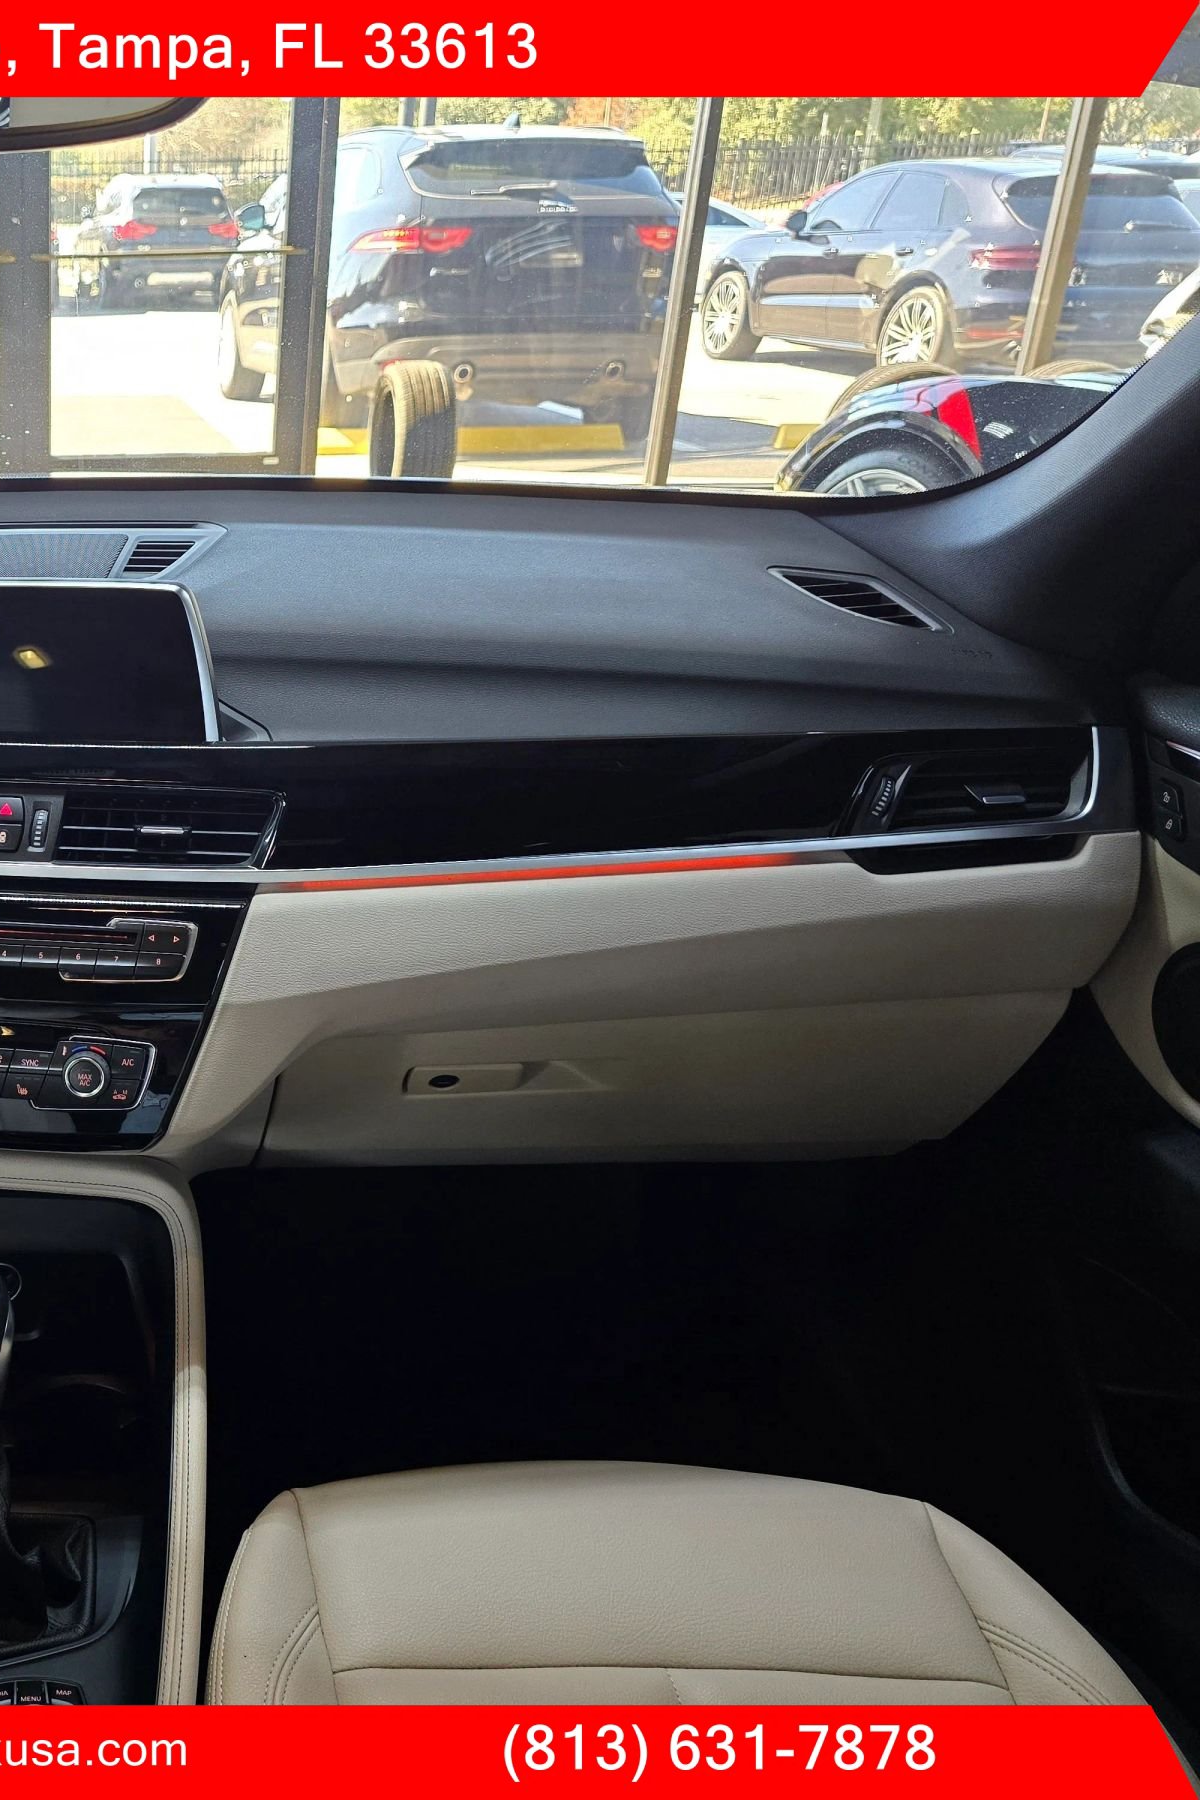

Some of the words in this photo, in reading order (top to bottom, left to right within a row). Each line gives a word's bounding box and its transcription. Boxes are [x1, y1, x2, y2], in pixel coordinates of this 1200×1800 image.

[1, 950, 7, 958] 4
[38, 951, 44, 959] 5
[75, 953, 81, 961] 6
[113, 955, 119, 963] 7
[156, 958, 161, 966] 8
[20, 1058, 40, 1067] SYNC
[121, 1058, 135, 1067] A/C
[77, 1073, 93, 1081] MAX
[79, 1079, 91, 1087] A/C
